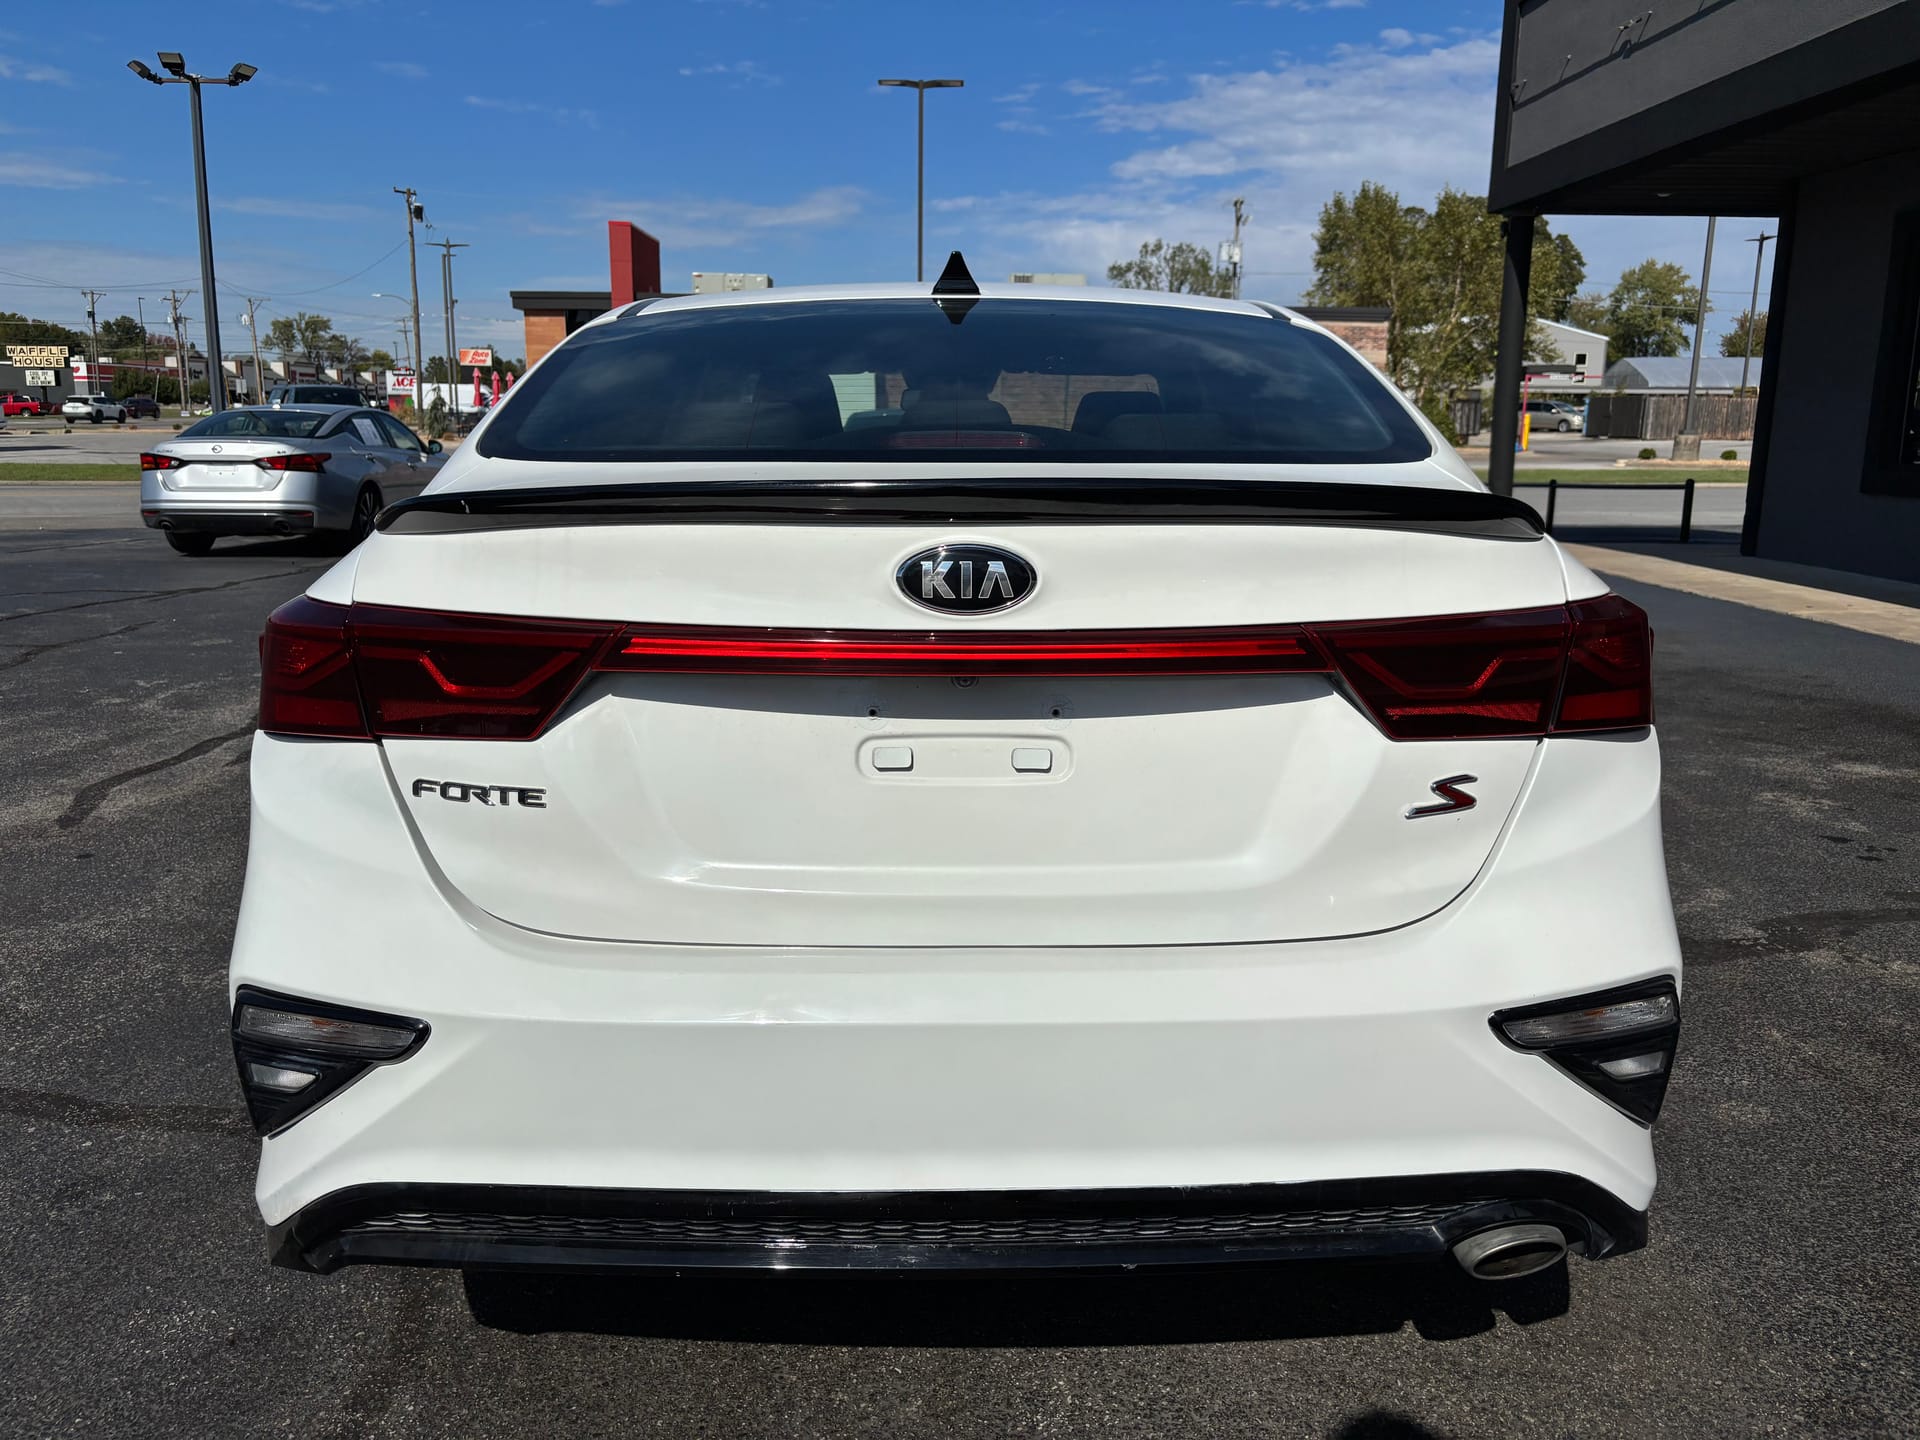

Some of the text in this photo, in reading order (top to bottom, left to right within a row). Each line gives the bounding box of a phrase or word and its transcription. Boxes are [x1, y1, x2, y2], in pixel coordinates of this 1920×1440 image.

[7, 347, 67, 355] WAFFLE
[14, 358, 63, 366] HOUSE
[392, 376, 417, 387] ACE
[920, 560, 1014, 599] KIA
[412, 778, 547, 808] FORTE
[1404, 774, 1478, 820] S
